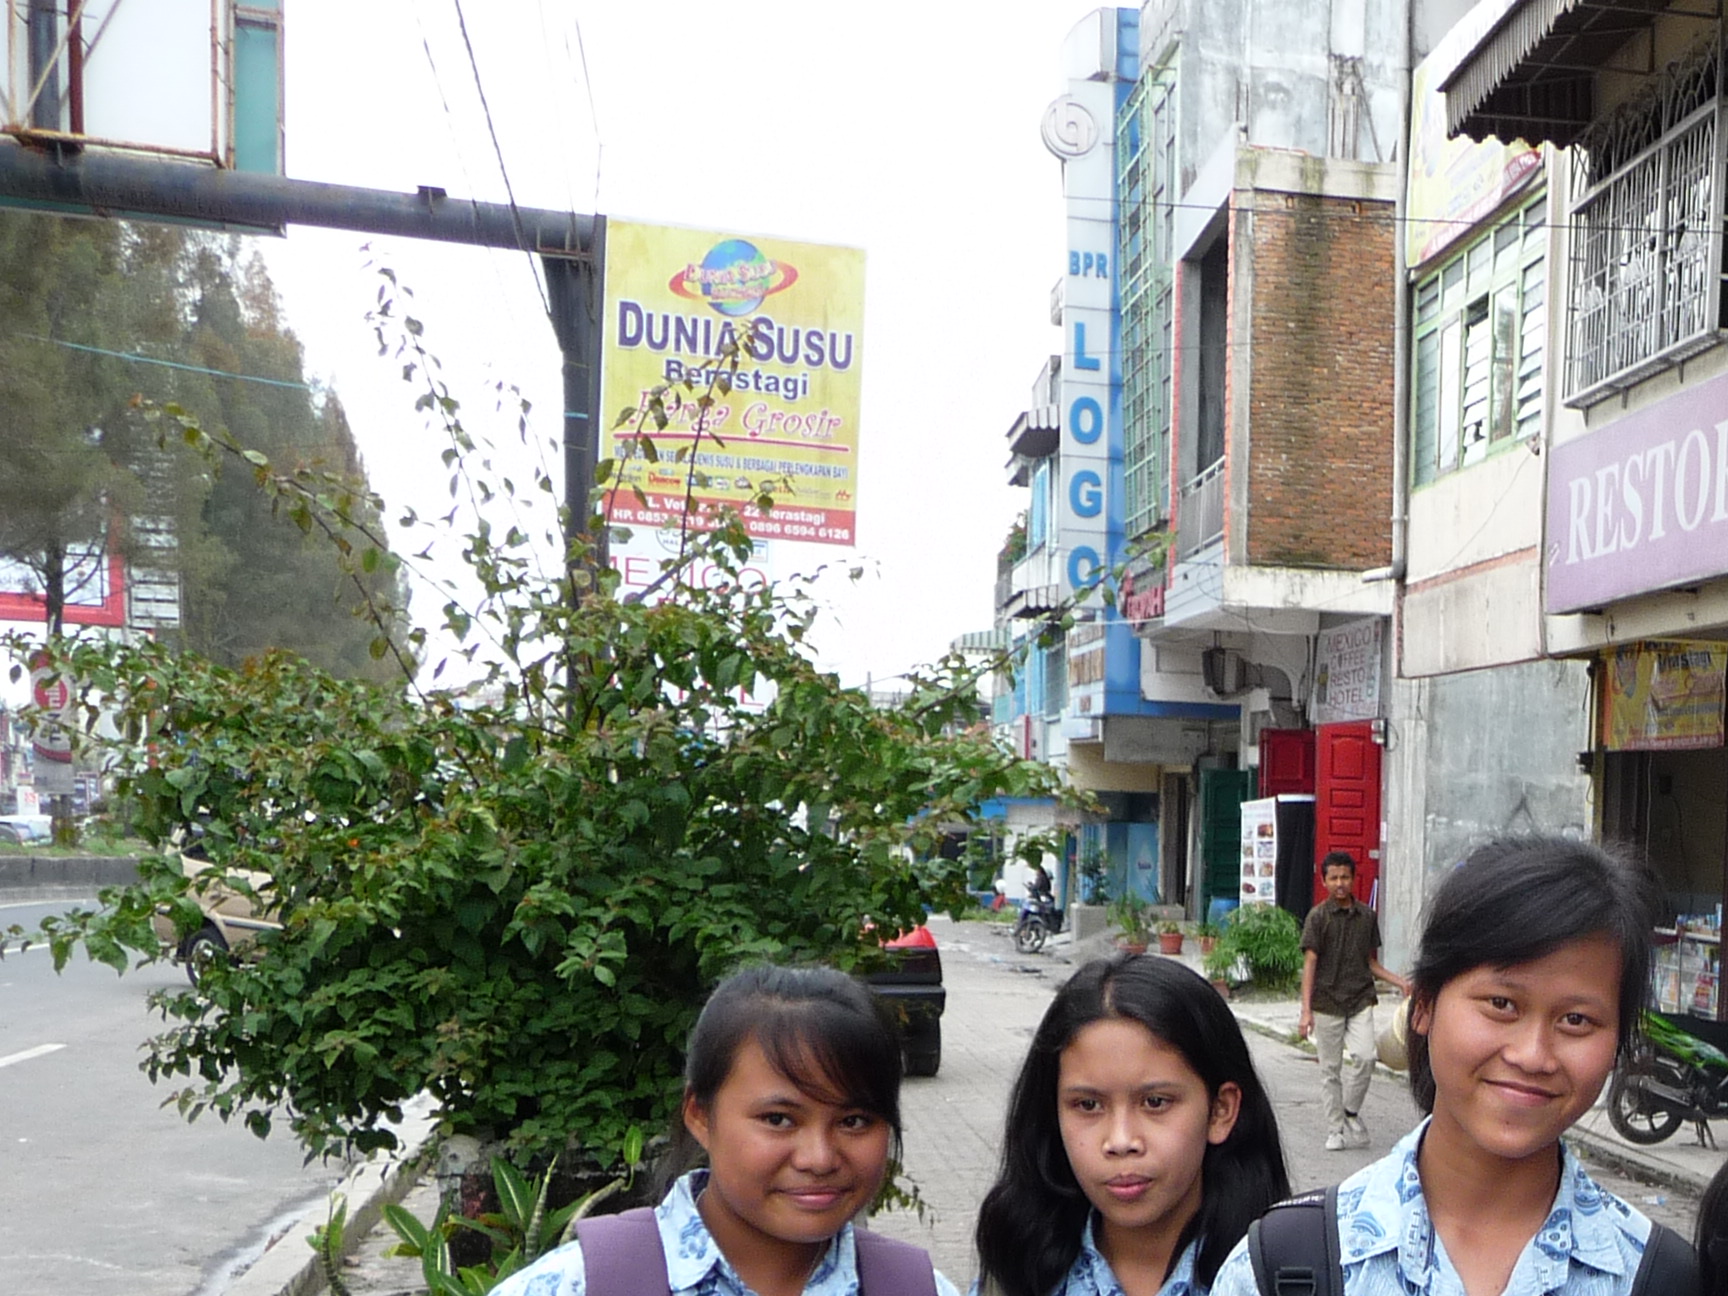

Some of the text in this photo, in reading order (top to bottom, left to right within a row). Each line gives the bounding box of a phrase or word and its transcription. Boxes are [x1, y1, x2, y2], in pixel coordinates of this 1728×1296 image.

[1068, 250, 1107, 279] BPR
[618, 301, 852, 370] DUNIA SUSU
[743, 402, 842, 438] Grosir
[716, 455, 734, 468] SUSU
[1068, 321, 1103, 593] LOGO
[744, 505, 759, 517] 22
[750, 522, 781, 534] 0896
[1327, 625, 1371, 653] MEXICO
[1330, 666, 1366, 687] RESTO
[1329, 688, 1364, 706] HOTEL
